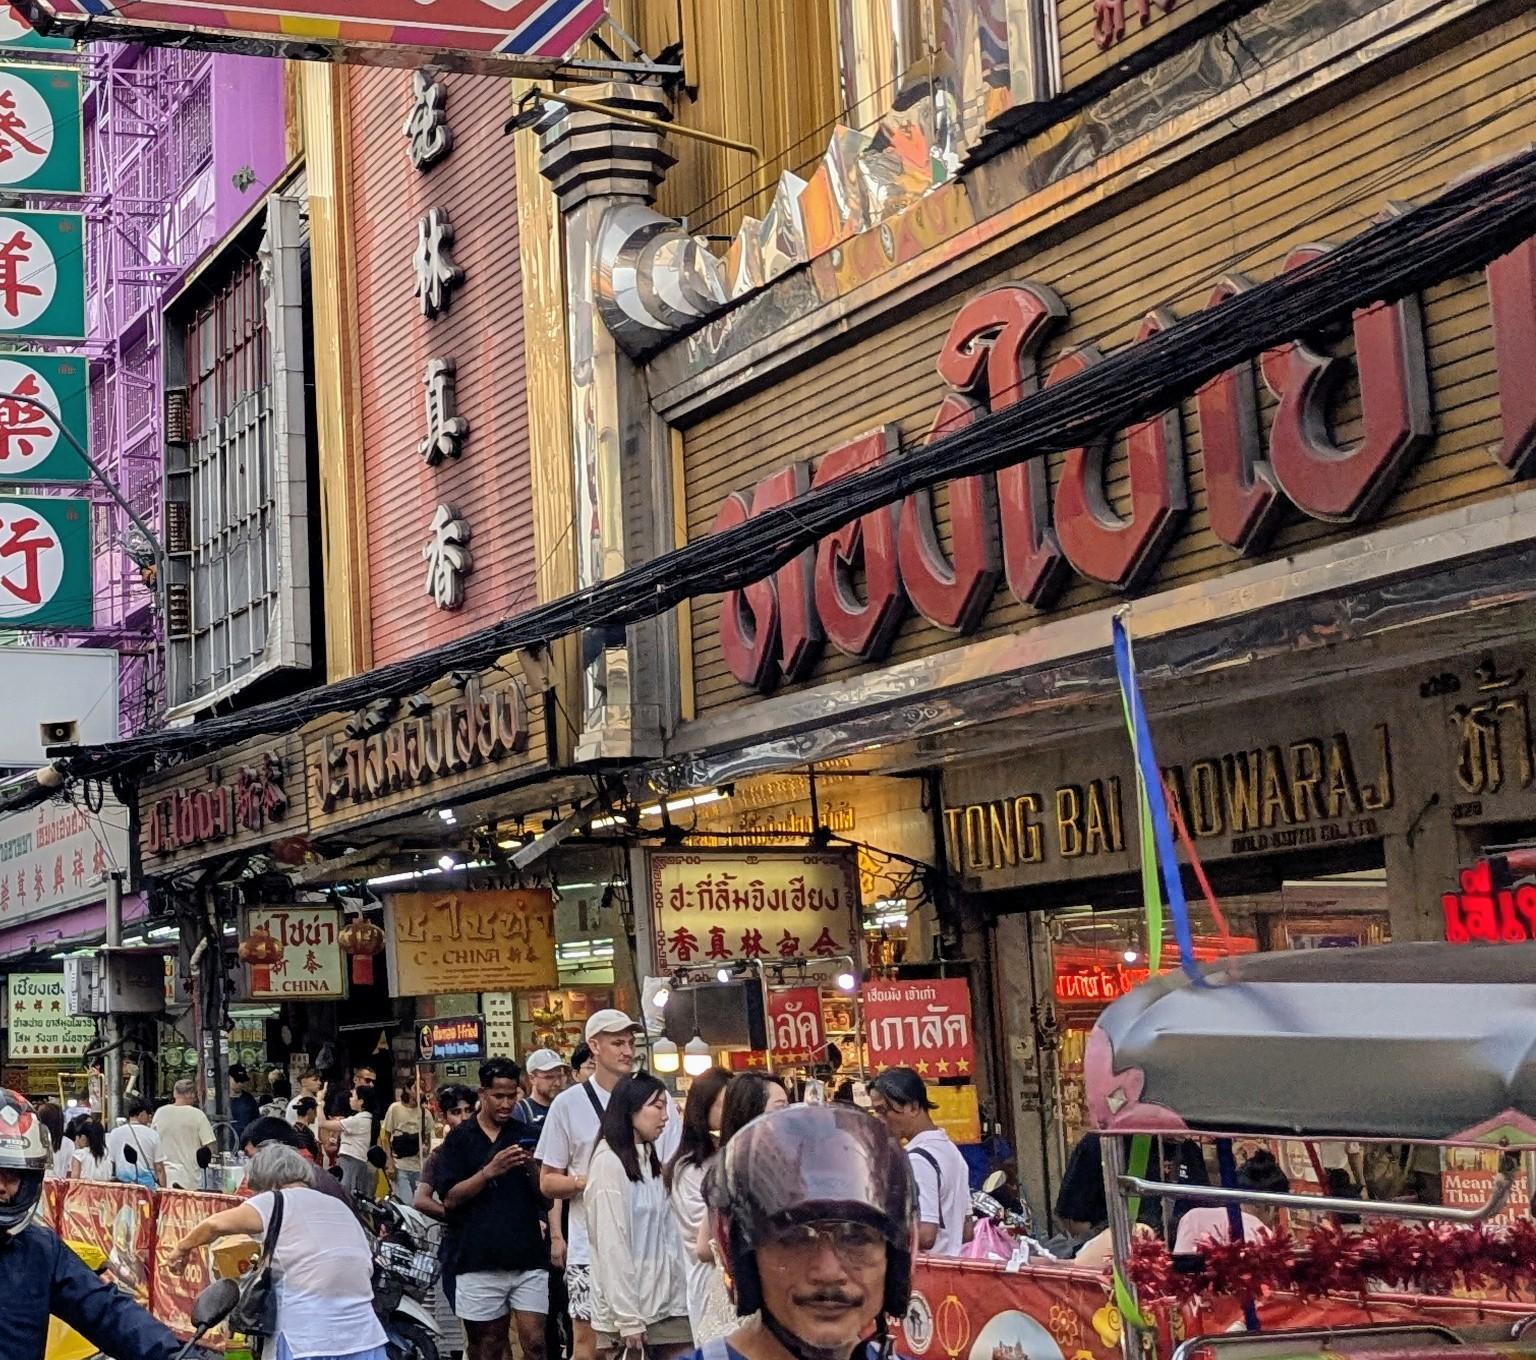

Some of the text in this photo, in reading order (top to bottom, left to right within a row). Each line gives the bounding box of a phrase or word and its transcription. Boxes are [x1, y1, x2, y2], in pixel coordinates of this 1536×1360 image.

[944, 790, 1043, 872] TONG
[1056, 775, 1126, 858] BAI
[1164, 723, 1395, 842] OWARAJ
[442, 949, 501, 965] CHINA
[282, 978, 330, 993] CHINA
[1447, 1188, 1486, 1204] Thai
